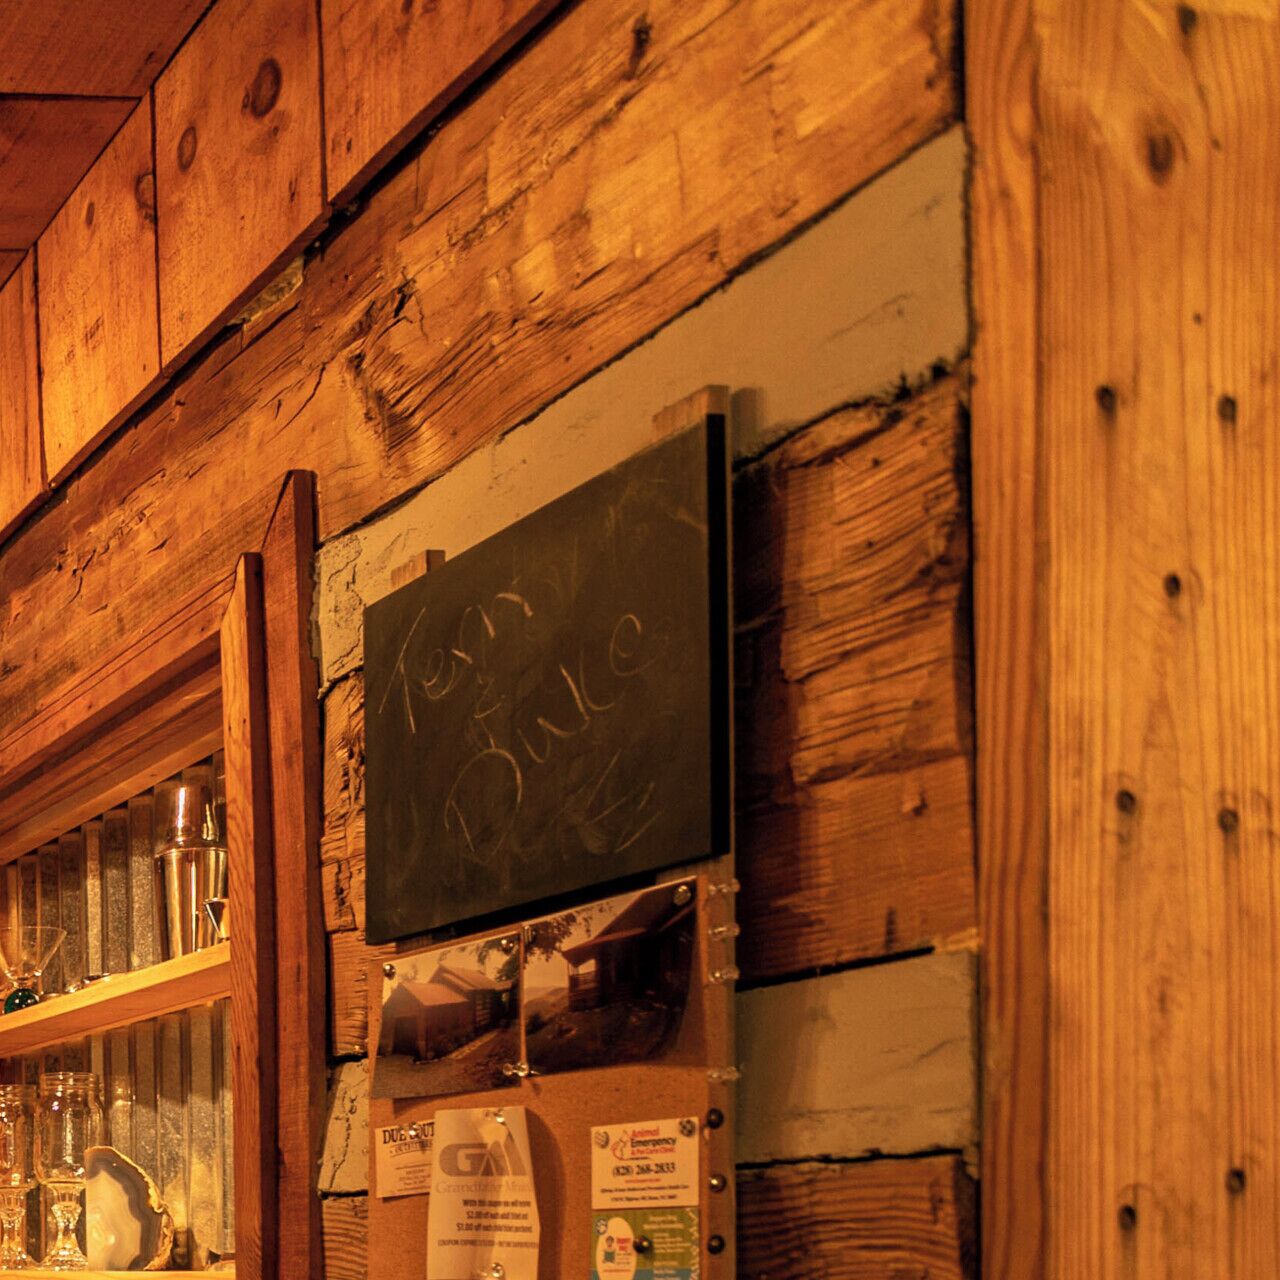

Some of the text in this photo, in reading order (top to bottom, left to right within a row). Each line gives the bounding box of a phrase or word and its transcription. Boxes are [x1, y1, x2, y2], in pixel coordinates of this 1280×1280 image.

[382, 1121, 435, 1145] DUE OUT
[631, 1126, 660, 1137] Animal
[630, 1137, 677, 1148] Emergency
[612, 1165, 633, 1177] (828)
